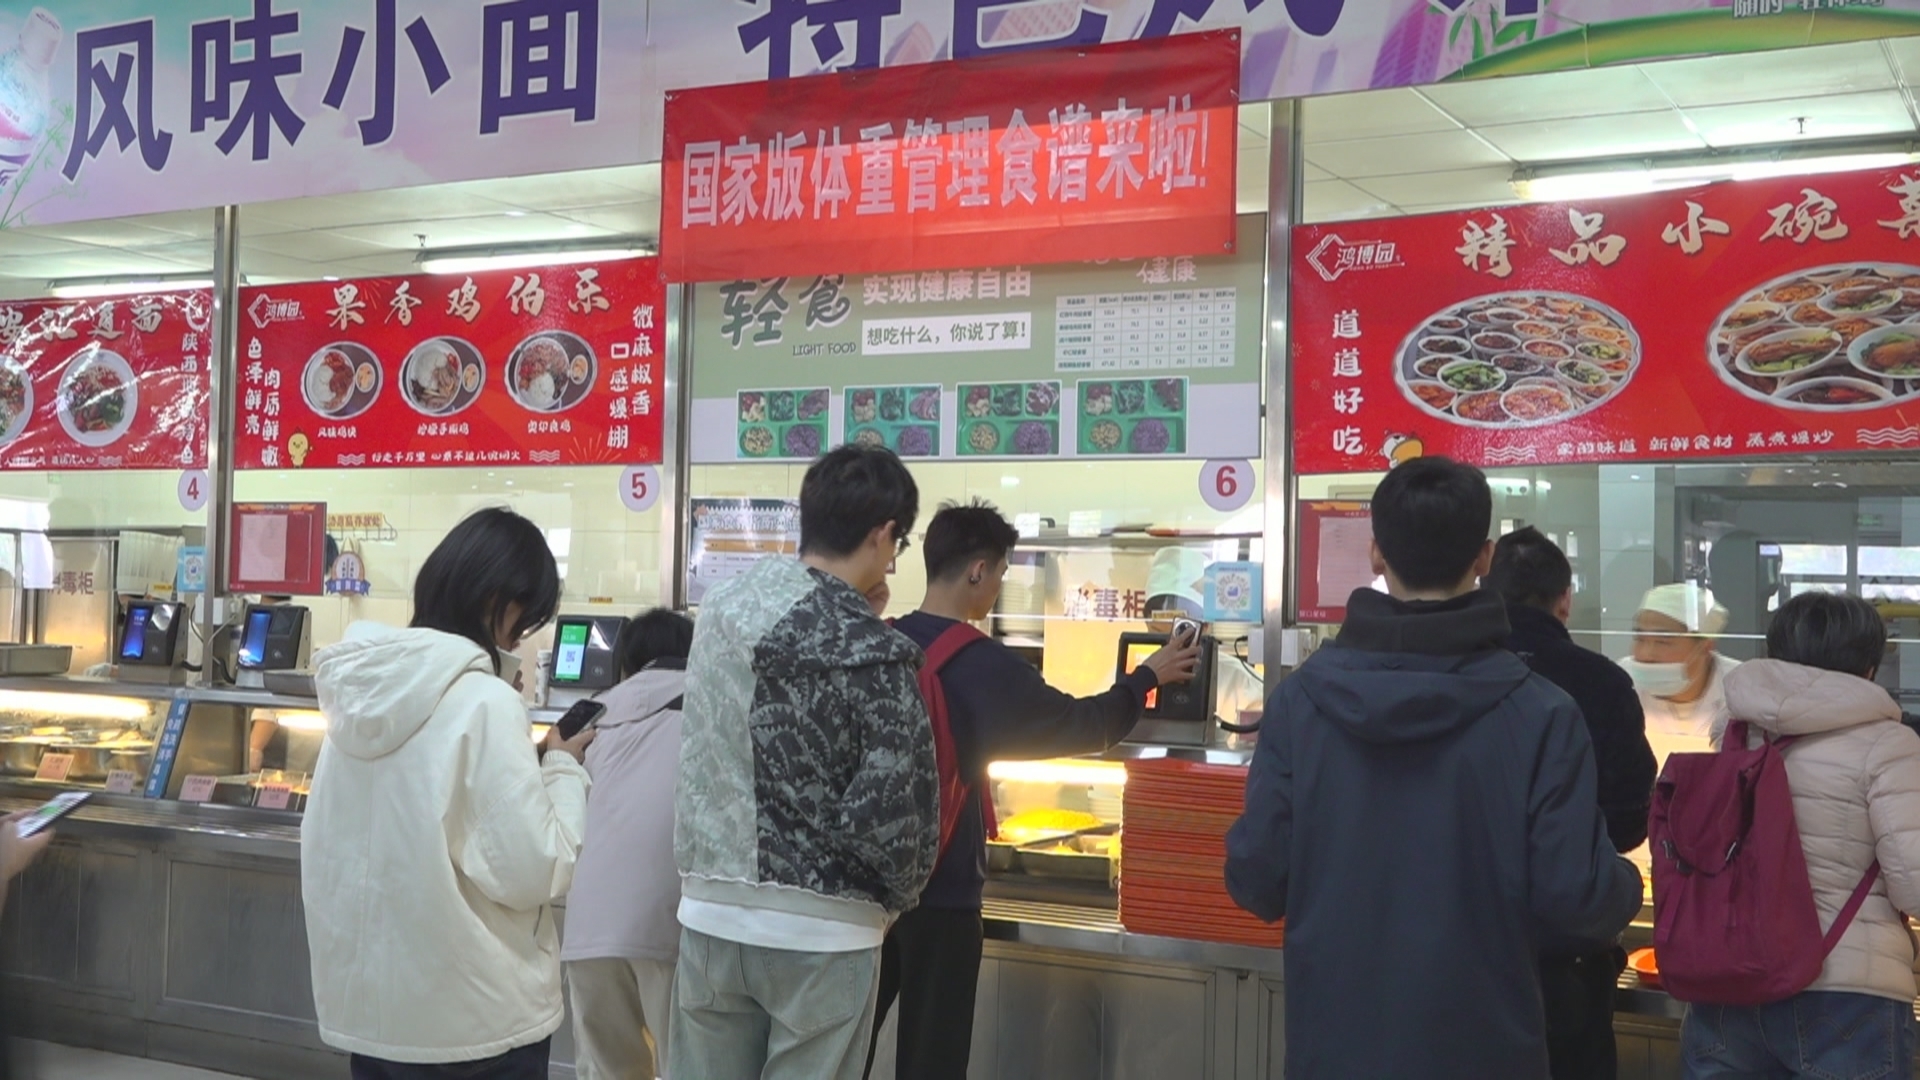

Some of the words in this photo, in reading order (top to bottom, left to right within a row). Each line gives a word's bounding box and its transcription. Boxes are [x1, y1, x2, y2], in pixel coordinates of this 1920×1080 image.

[61, 0, 600, 182] 风味小面
[681, 94, 1209, 229] 国家版体重管理食谱来啦！
[1136, 255, 1198, 284] 健康
[1335, 242, 1396, 268] 鸿博园
[862, 268, 1031, 304] 实现健康自由
[720, 273, 851, 349] 轻食
[793, 345, 824, 357] LIGHT
[828, 342, 857, 355] FOOD
[866, 320, 1027, 346] 想吃什么，你说了算！
[632, 303, 654, 416] 微麻椒香
[245, 336, 263, 435] 色泽鲜亮
[607, 342, 630, 449] 口感爆棚
[1332, 309, 1364, 455] 道道好吃
[261, 367, 281, 467] 肉质鲜嫩
[1556, 439, 1637, 456] 家的味道
[1649, 434, 1733, 452] 新鲜食材
[1746, 430, 1835, 448] 蒸煮爆炒
[186, 477, 200, 500] 4
[631, 472, 647, 499] 5
[1216, 465, 1237, 497] 6
